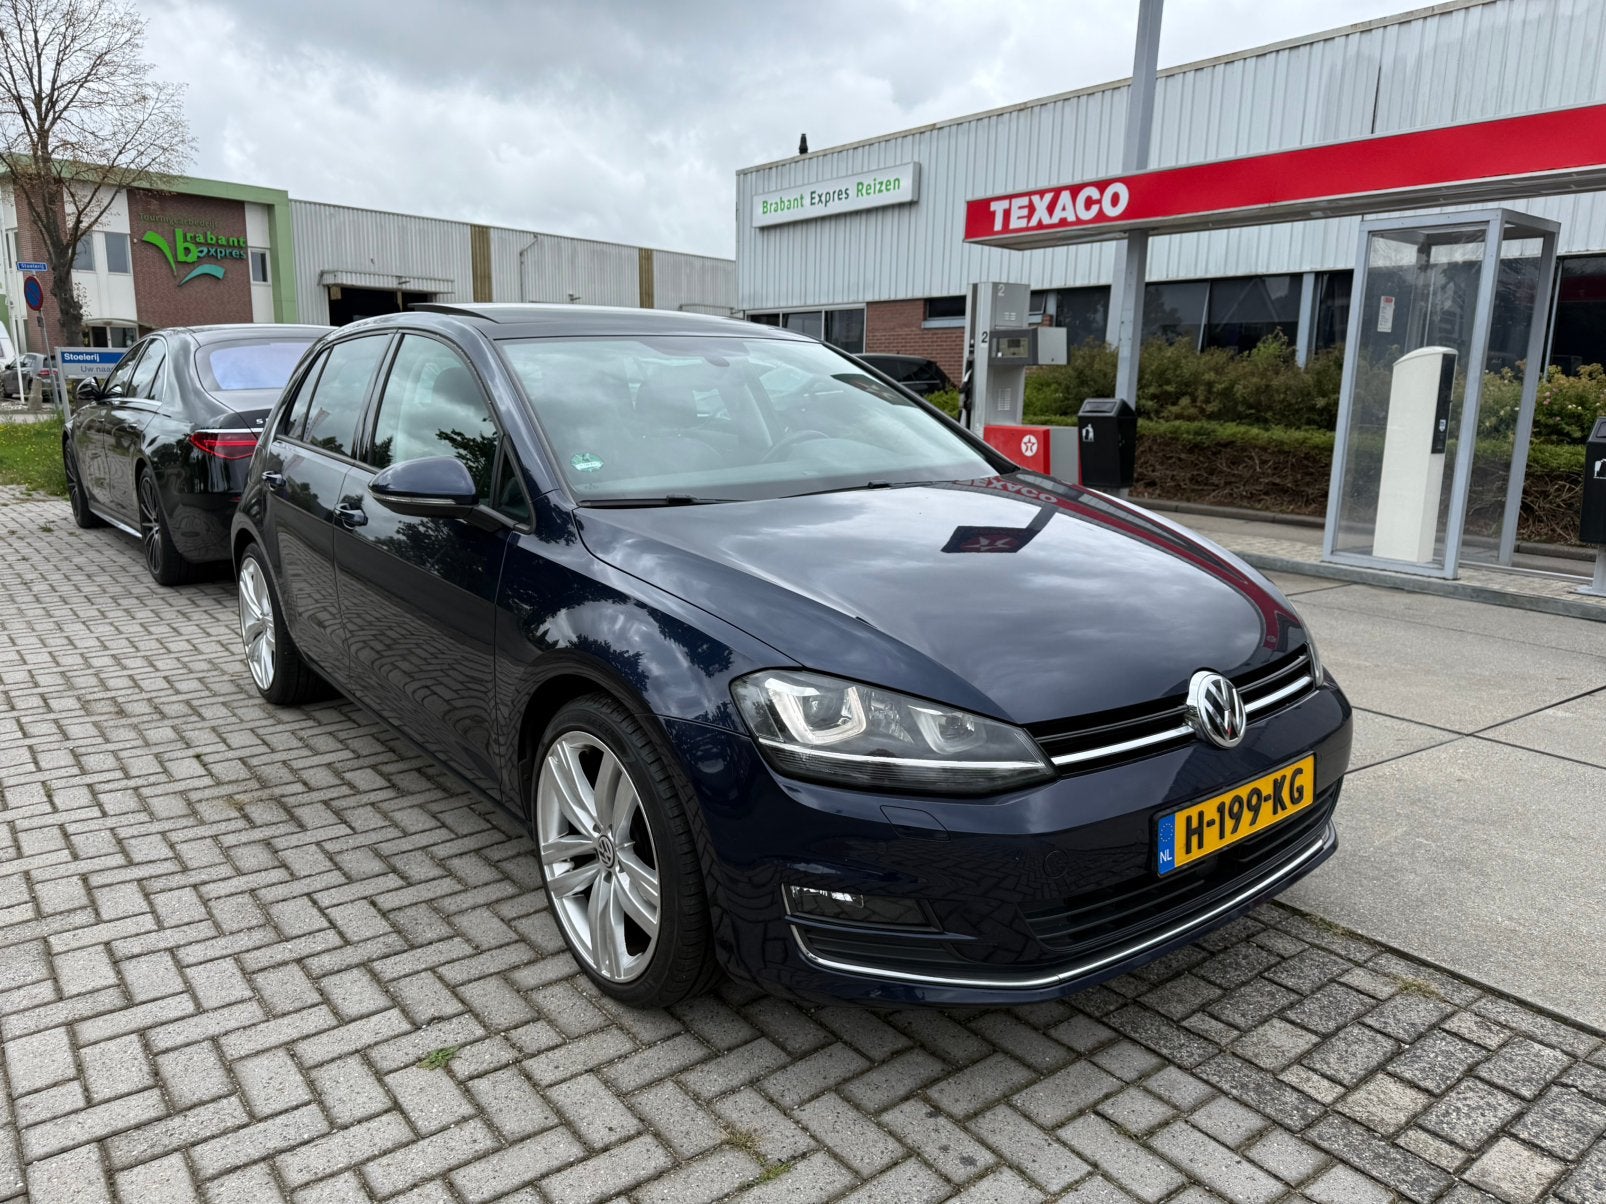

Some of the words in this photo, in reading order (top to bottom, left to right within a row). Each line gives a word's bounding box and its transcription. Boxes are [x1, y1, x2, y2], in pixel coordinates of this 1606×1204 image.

[762, 193, 804, 214] Brabant
[810, 187, 850, 207] Expres
[856, 177, 901, 197] Reizen
[990, 182, 1130, 231] TEXACO
[998, 284, 1005, 296] 2
[981, 331, 988, 343] 2
[64, 353, 100, 362] Stoelerij
[1185, 767, 1304, 855] H-199-KG
[1159, 849, 1172, 864] NL
